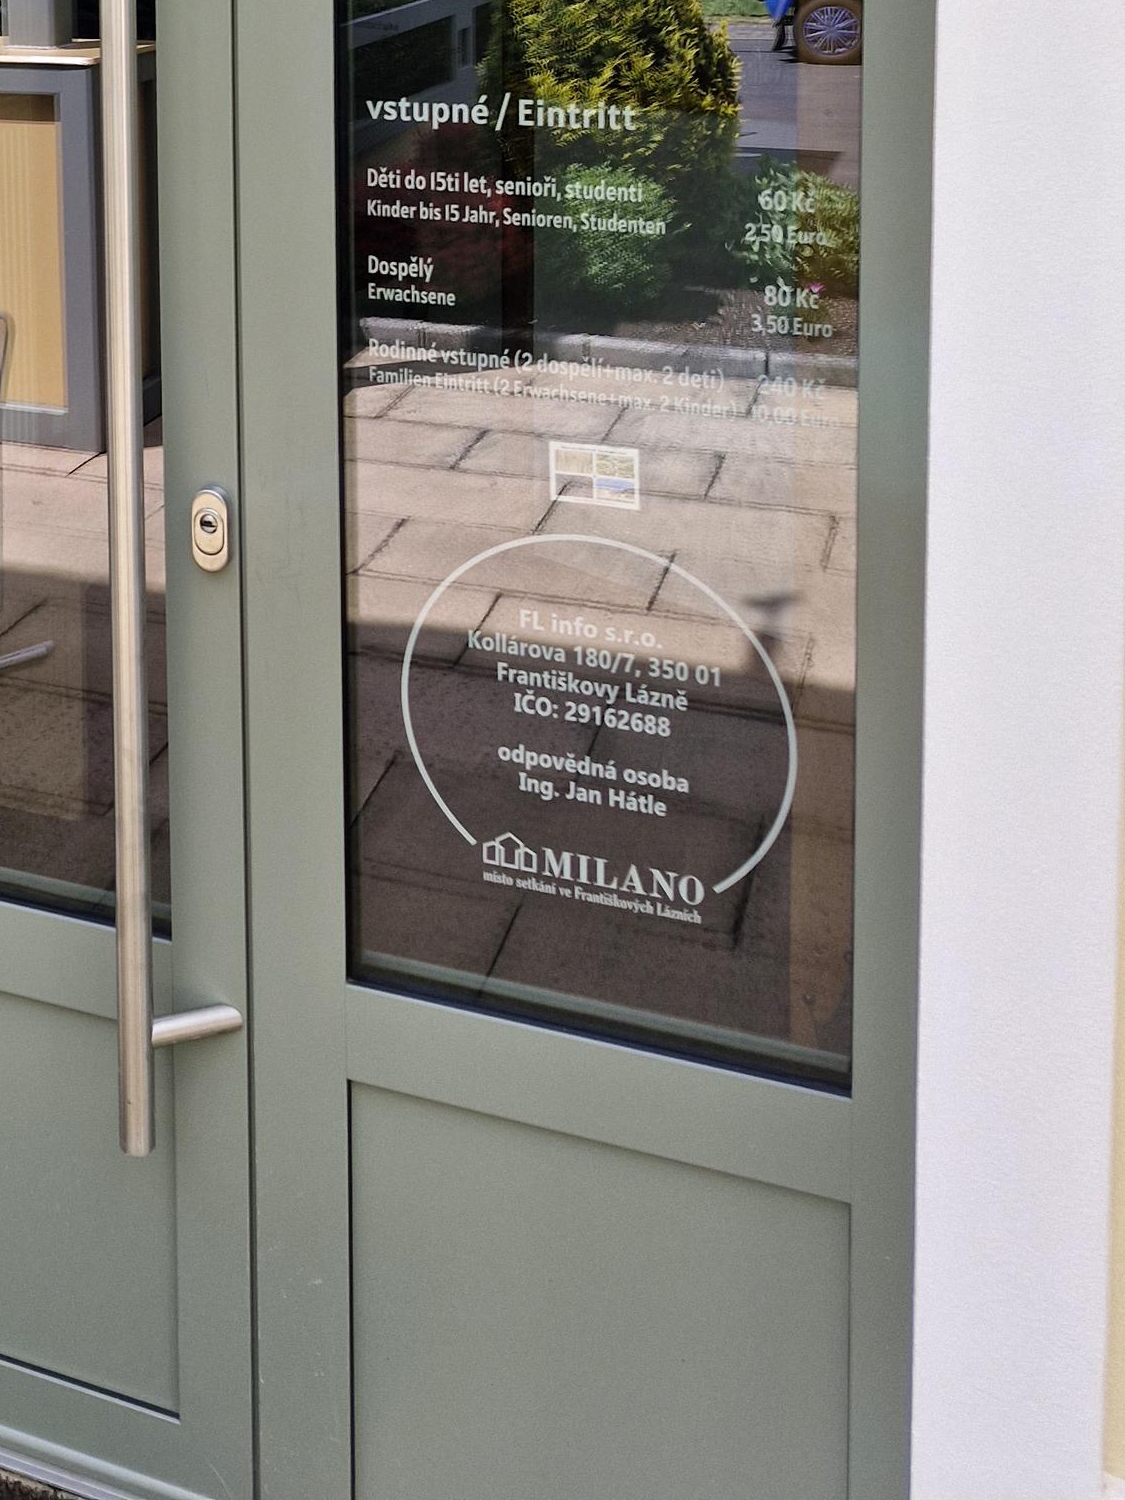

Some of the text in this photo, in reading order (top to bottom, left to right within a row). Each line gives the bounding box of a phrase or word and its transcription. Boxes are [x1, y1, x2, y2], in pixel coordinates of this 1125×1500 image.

[366, 91, 636, 132] vstupné / Eintritt
[366, 164, 644, 204] Děti do 15ti let, senioři, studenti
[757, 188, 817, 214] 60 Kč
[366, 198, 667, 236] Kinder bis 15 Jahr, Senioren, Studenten
[786, 225, 828, 246] Euro
[367, 254, 434, 284] Dospělý
[367, 282, 457, 307] Erwachsene
[763, 284, 820, 310] 80 Kč
[751, 313, 833, 338] 3,50 Euro
[368, 338, 438, 364] Rodinné
[440, 348, 510, 372] vstupné
[514, 348, 534, 375] (2
[661, 365, 674, 387] 2
[368, 365, 432, 388] Familien
[434, 371, 491, 395] Eintritt
[493, 375, 510, 398] (2
[659, 395, 671, 414] 2
[756, 373, 796, 399] 240
[518, 609, 663, 649] FL info s.r.o.
[467, 629, 722, 688] Kollárova 180/7, 350 01
[496, 661, 690, 712] Františkovy Lázně
[513, 688, 672, 738] IČO: 29162688
[497, 743, 690, 794] odpovědná osoba
[517, 771, 668, 818] Ing. Jan Hátle
[541, 846, 706, 907] MILANO
[482, 870, 703, 925] místo setkání ve Františkových Lázních
